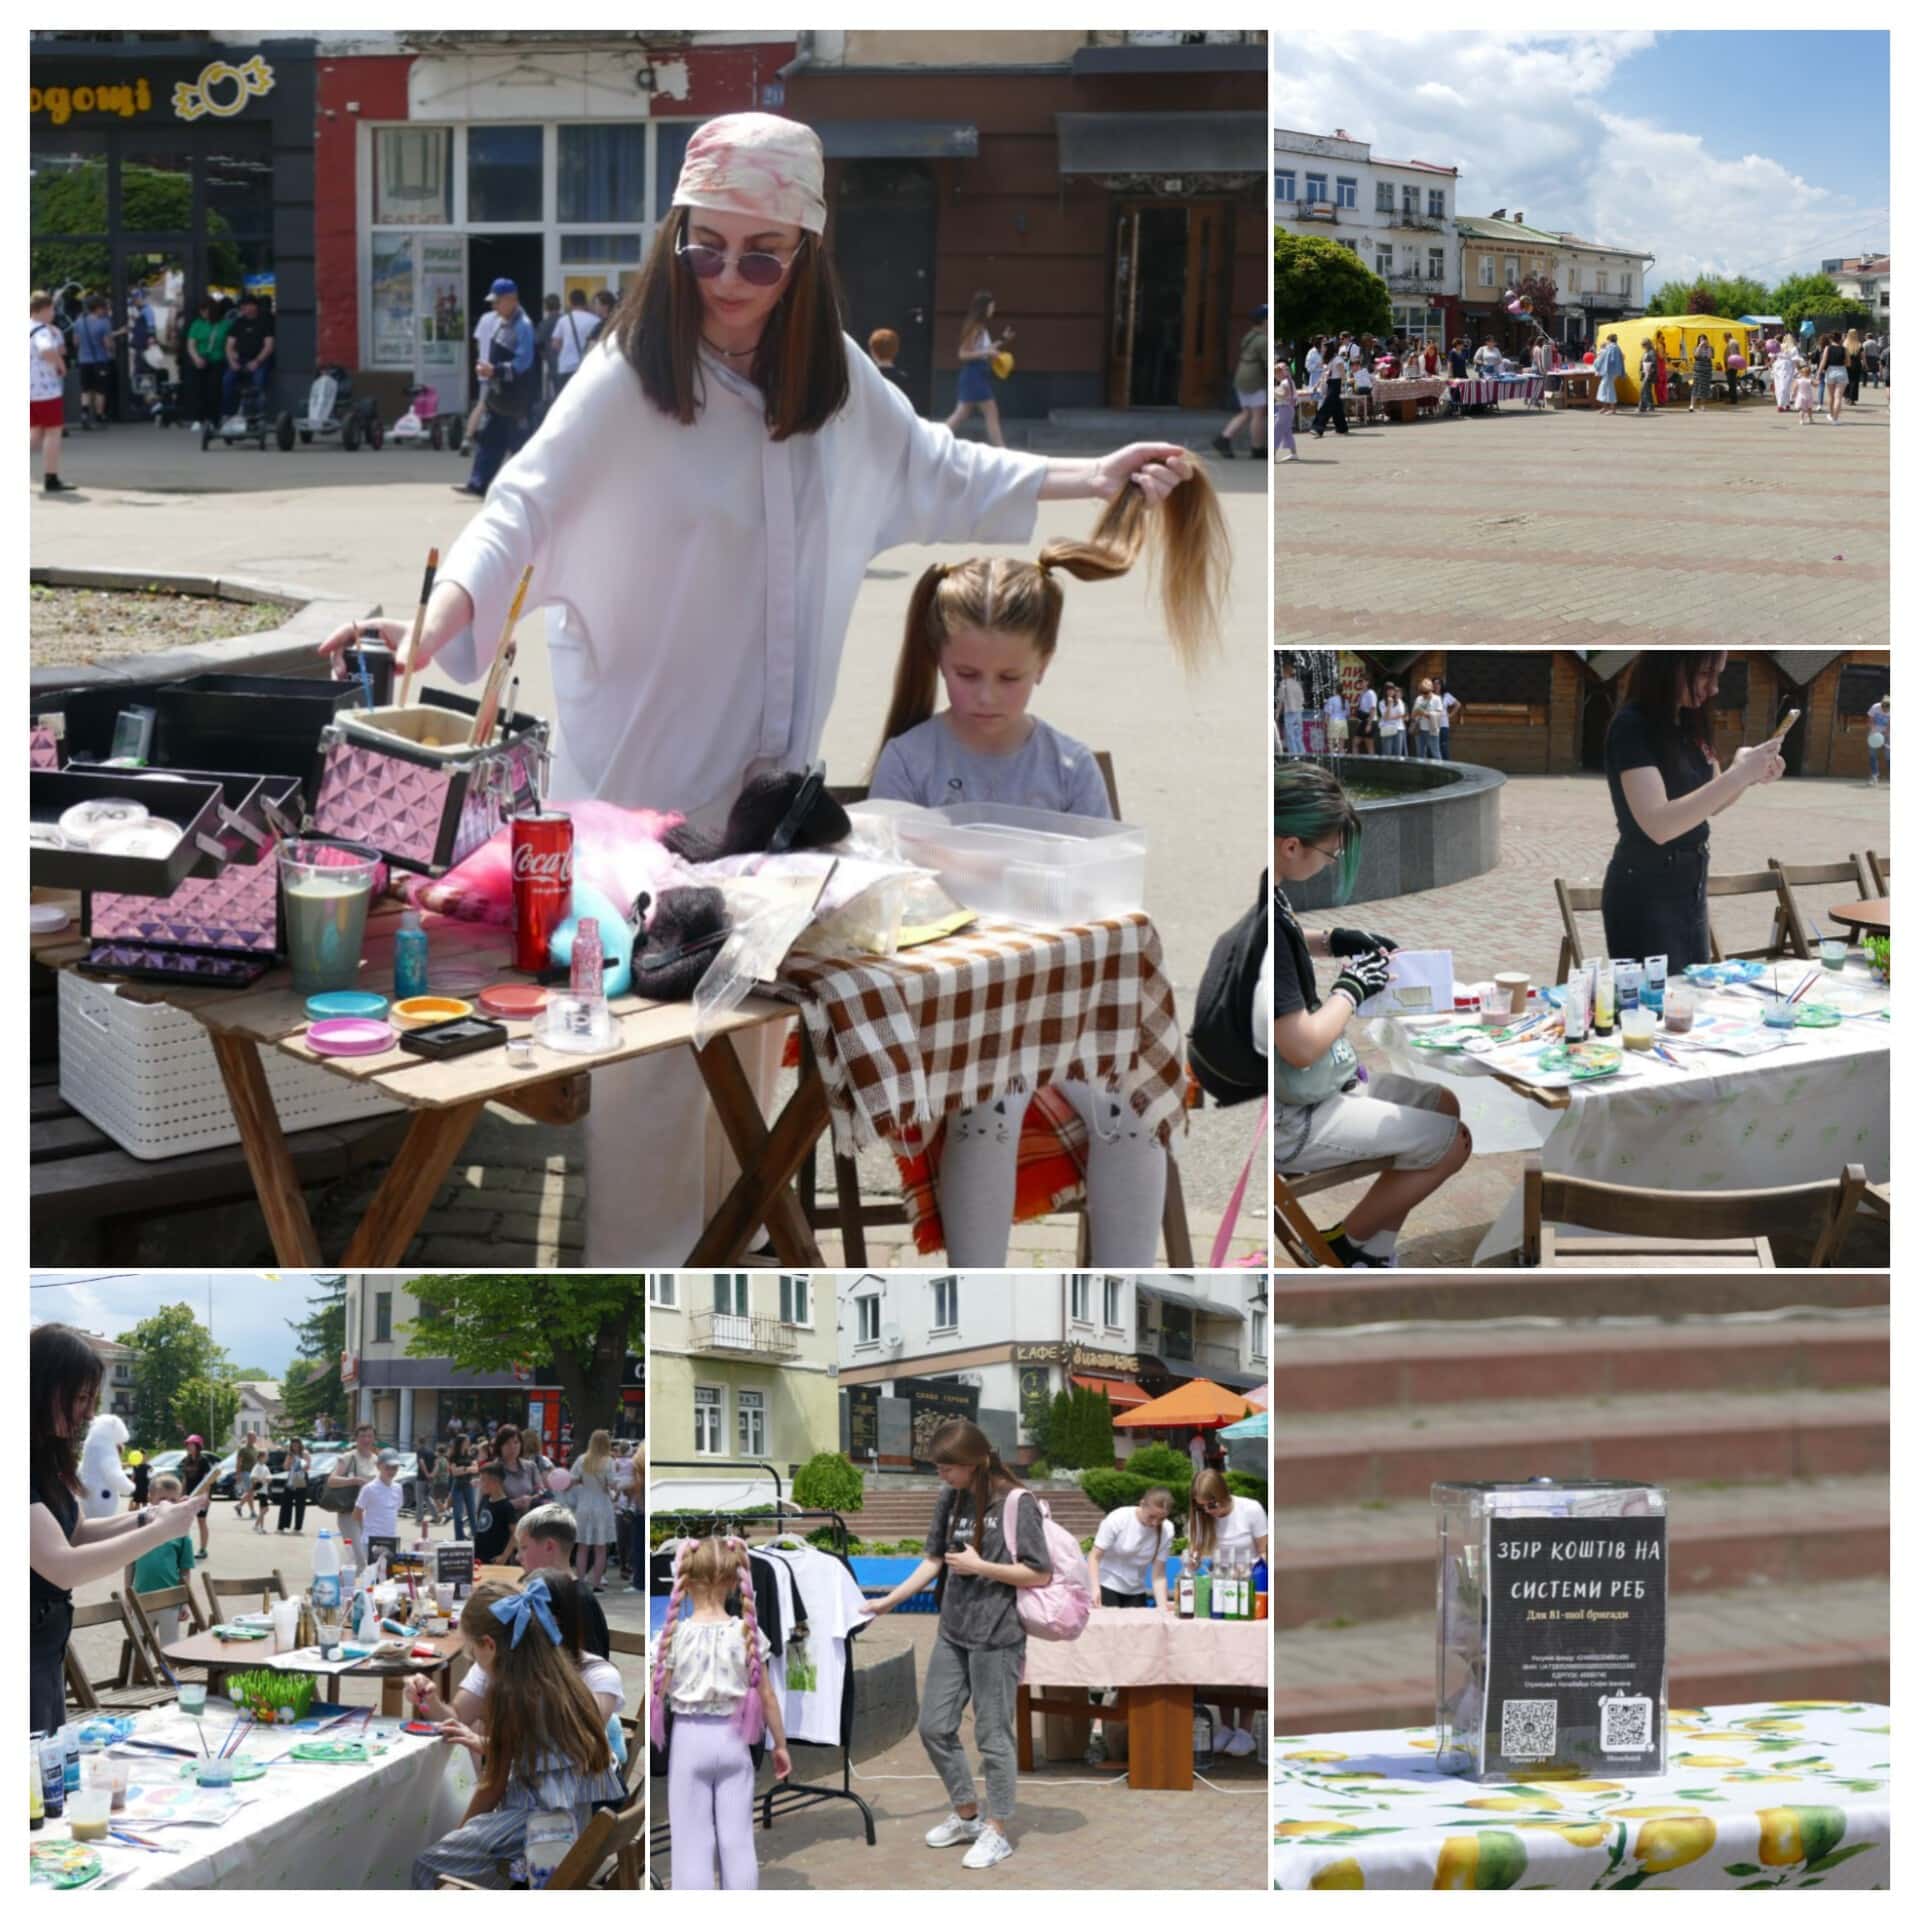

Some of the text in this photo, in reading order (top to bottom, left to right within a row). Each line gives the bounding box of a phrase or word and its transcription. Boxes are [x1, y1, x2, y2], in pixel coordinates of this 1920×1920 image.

[1016, 1345, 1057, 1360] КАФЕ
[1497, 1540, 1660, 1561] ЗБІР КОШТІВ НА
[1511, 1580, 1646, 1600] СИСТЕМИ РЕБ
[1526, 1609, 1547, 1620] Для
[1586, 1609, 1629, 1622] бригади
